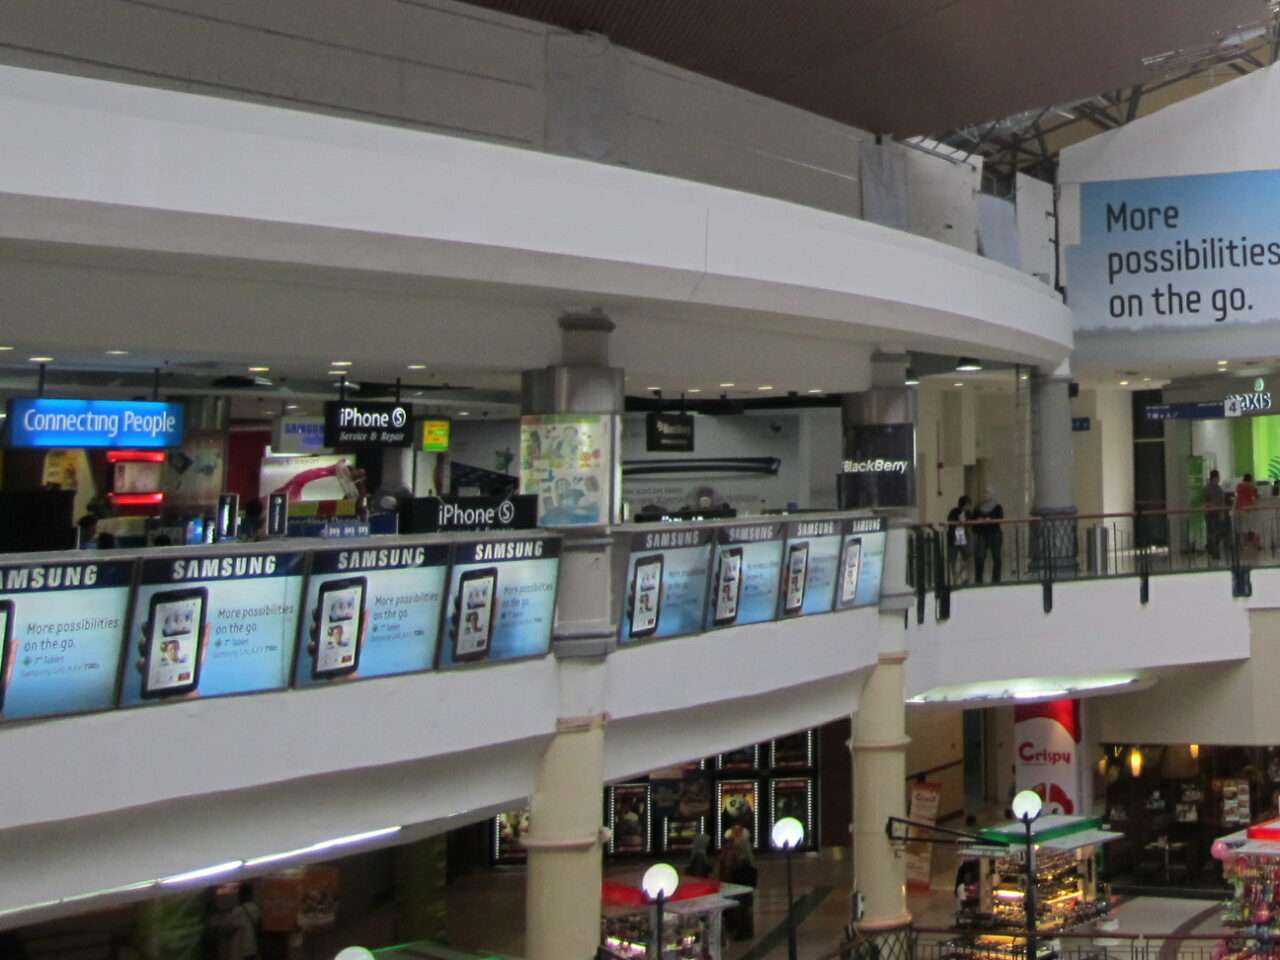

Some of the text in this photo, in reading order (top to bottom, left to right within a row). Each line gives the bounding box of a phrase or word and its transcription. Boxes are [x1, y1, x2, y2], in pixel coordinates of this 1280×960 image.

[1106, 201, 1180, 233] More
[1109, 283, 1253, 322] on the go.
[340, 407, 389, 428] iPhone
[1228, 401, 1237, 414] 4
[24, 409, 176, 437] Connecting People
[842, 459, 908, 474] BlackBerry
[438, 503, 495, 526] iPhone
[646, 530, 700, 548] SAMSUNG
[338, 547, 425, 569] SAMSUNG
[475, 540, 544, 560] SAMSUNG
[172, 555, 277, 580] SAMSUNG
[218, 608, 241, 620] More
[26, 616, 120, 636] More possibilities
[229, 623, 244, 634] the
[24, 639, 38, 653] on
[40, 638, 58, 650] the
[1018, 741, 1072, 764] Crispy
